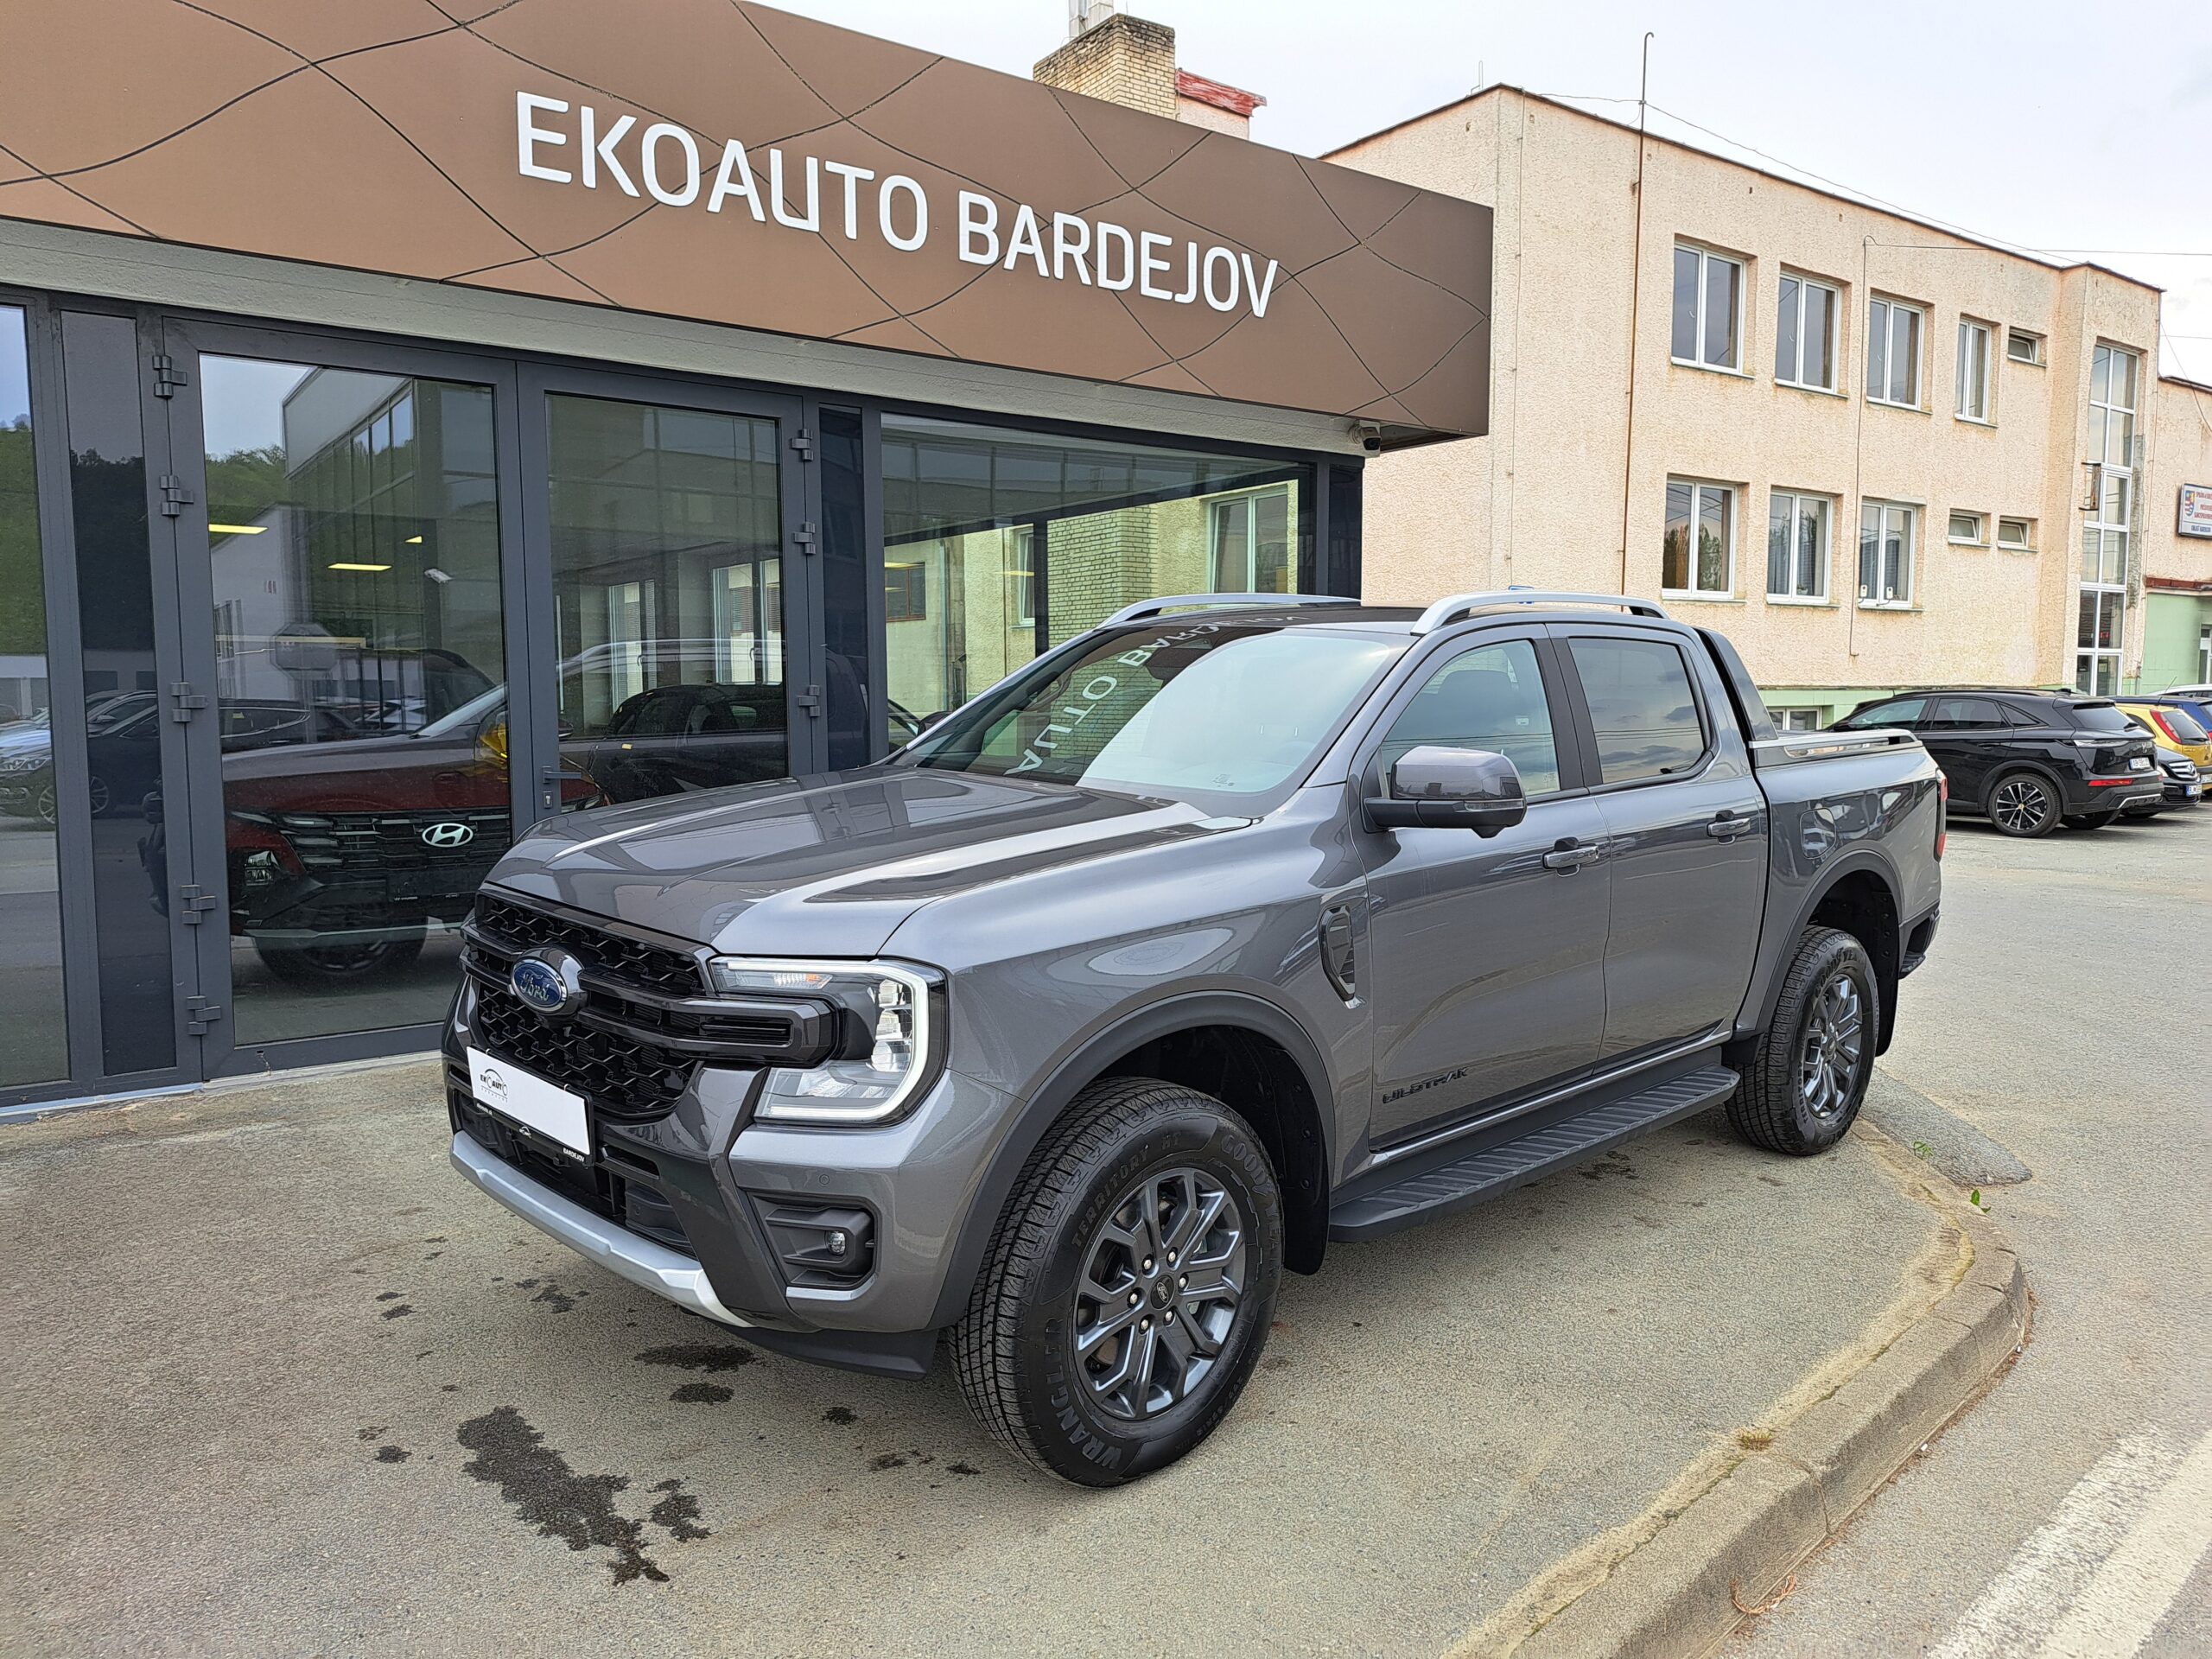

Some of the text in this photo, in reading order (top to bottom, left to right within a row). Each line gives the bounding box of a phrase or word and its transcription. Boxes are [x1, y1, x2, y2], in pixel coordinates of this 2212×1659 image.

[516, 91, 1279, 319] EKOAUTO BARDEJOV
[519, 969, 550, 1001] Ford
[1044, 1317, 1122, 1470] WRANGLER
